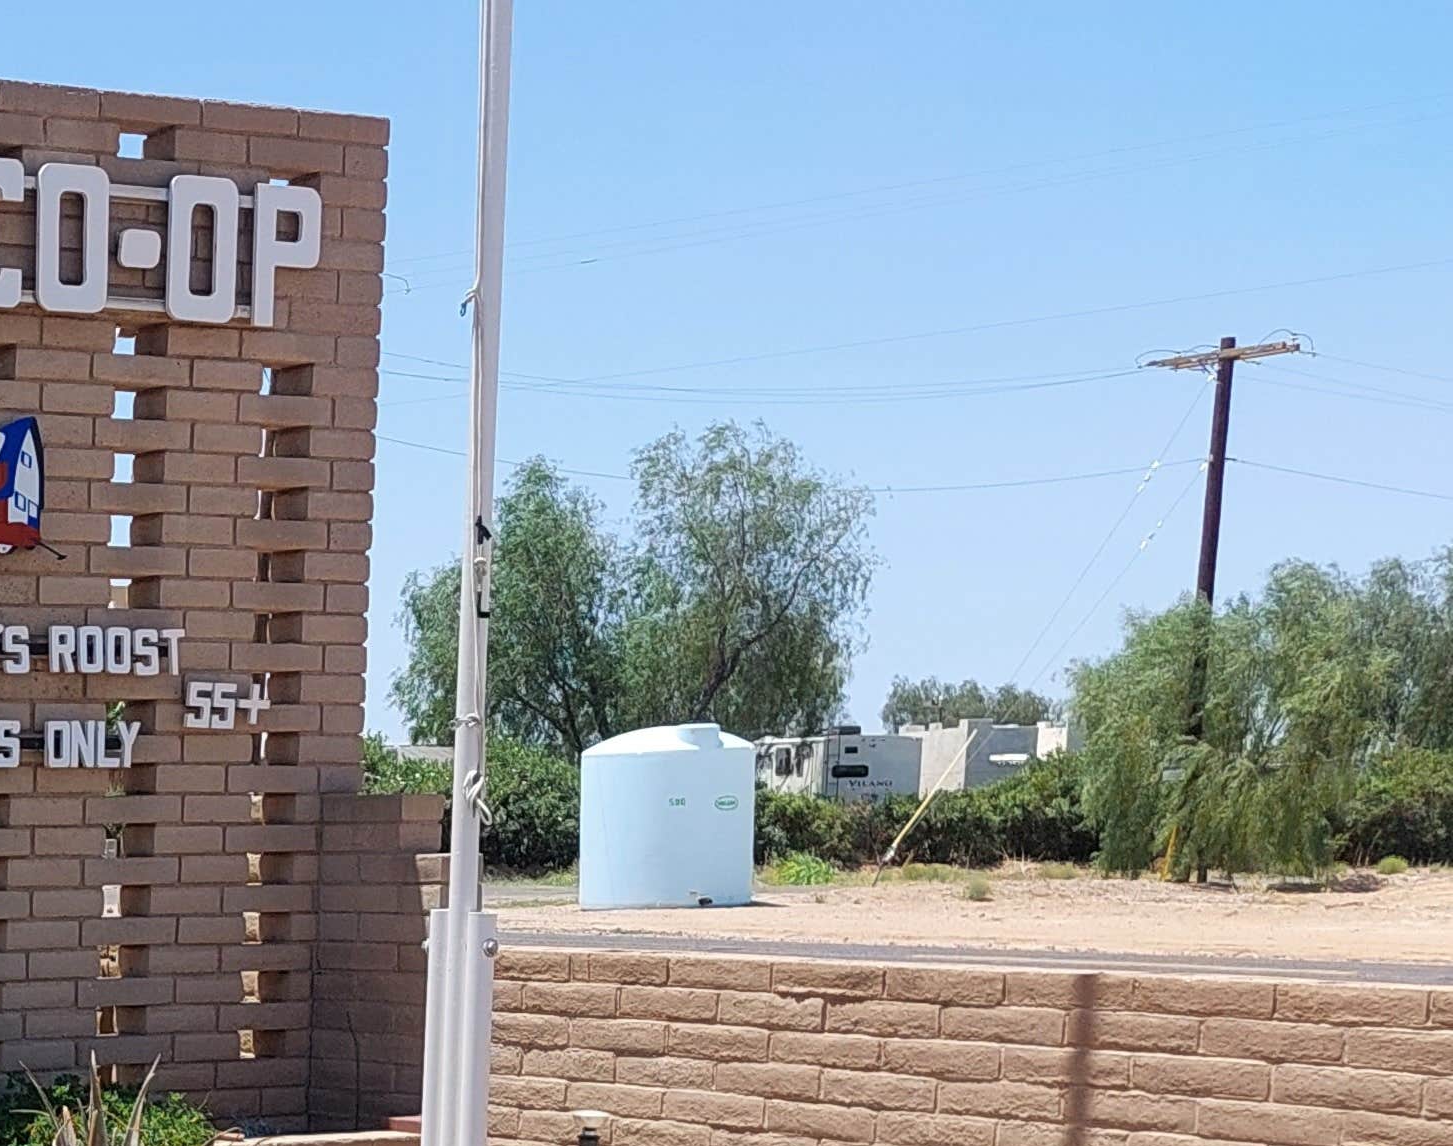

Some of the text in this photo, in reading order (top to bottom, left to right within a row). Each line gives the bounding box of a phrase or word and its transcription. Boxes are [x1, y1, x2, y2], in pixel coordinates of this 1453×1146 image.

[48, 624, 187, 677] ROOST
[183, 681, 272, 731] 55+
[43, 719, 143, 770] ONLY
